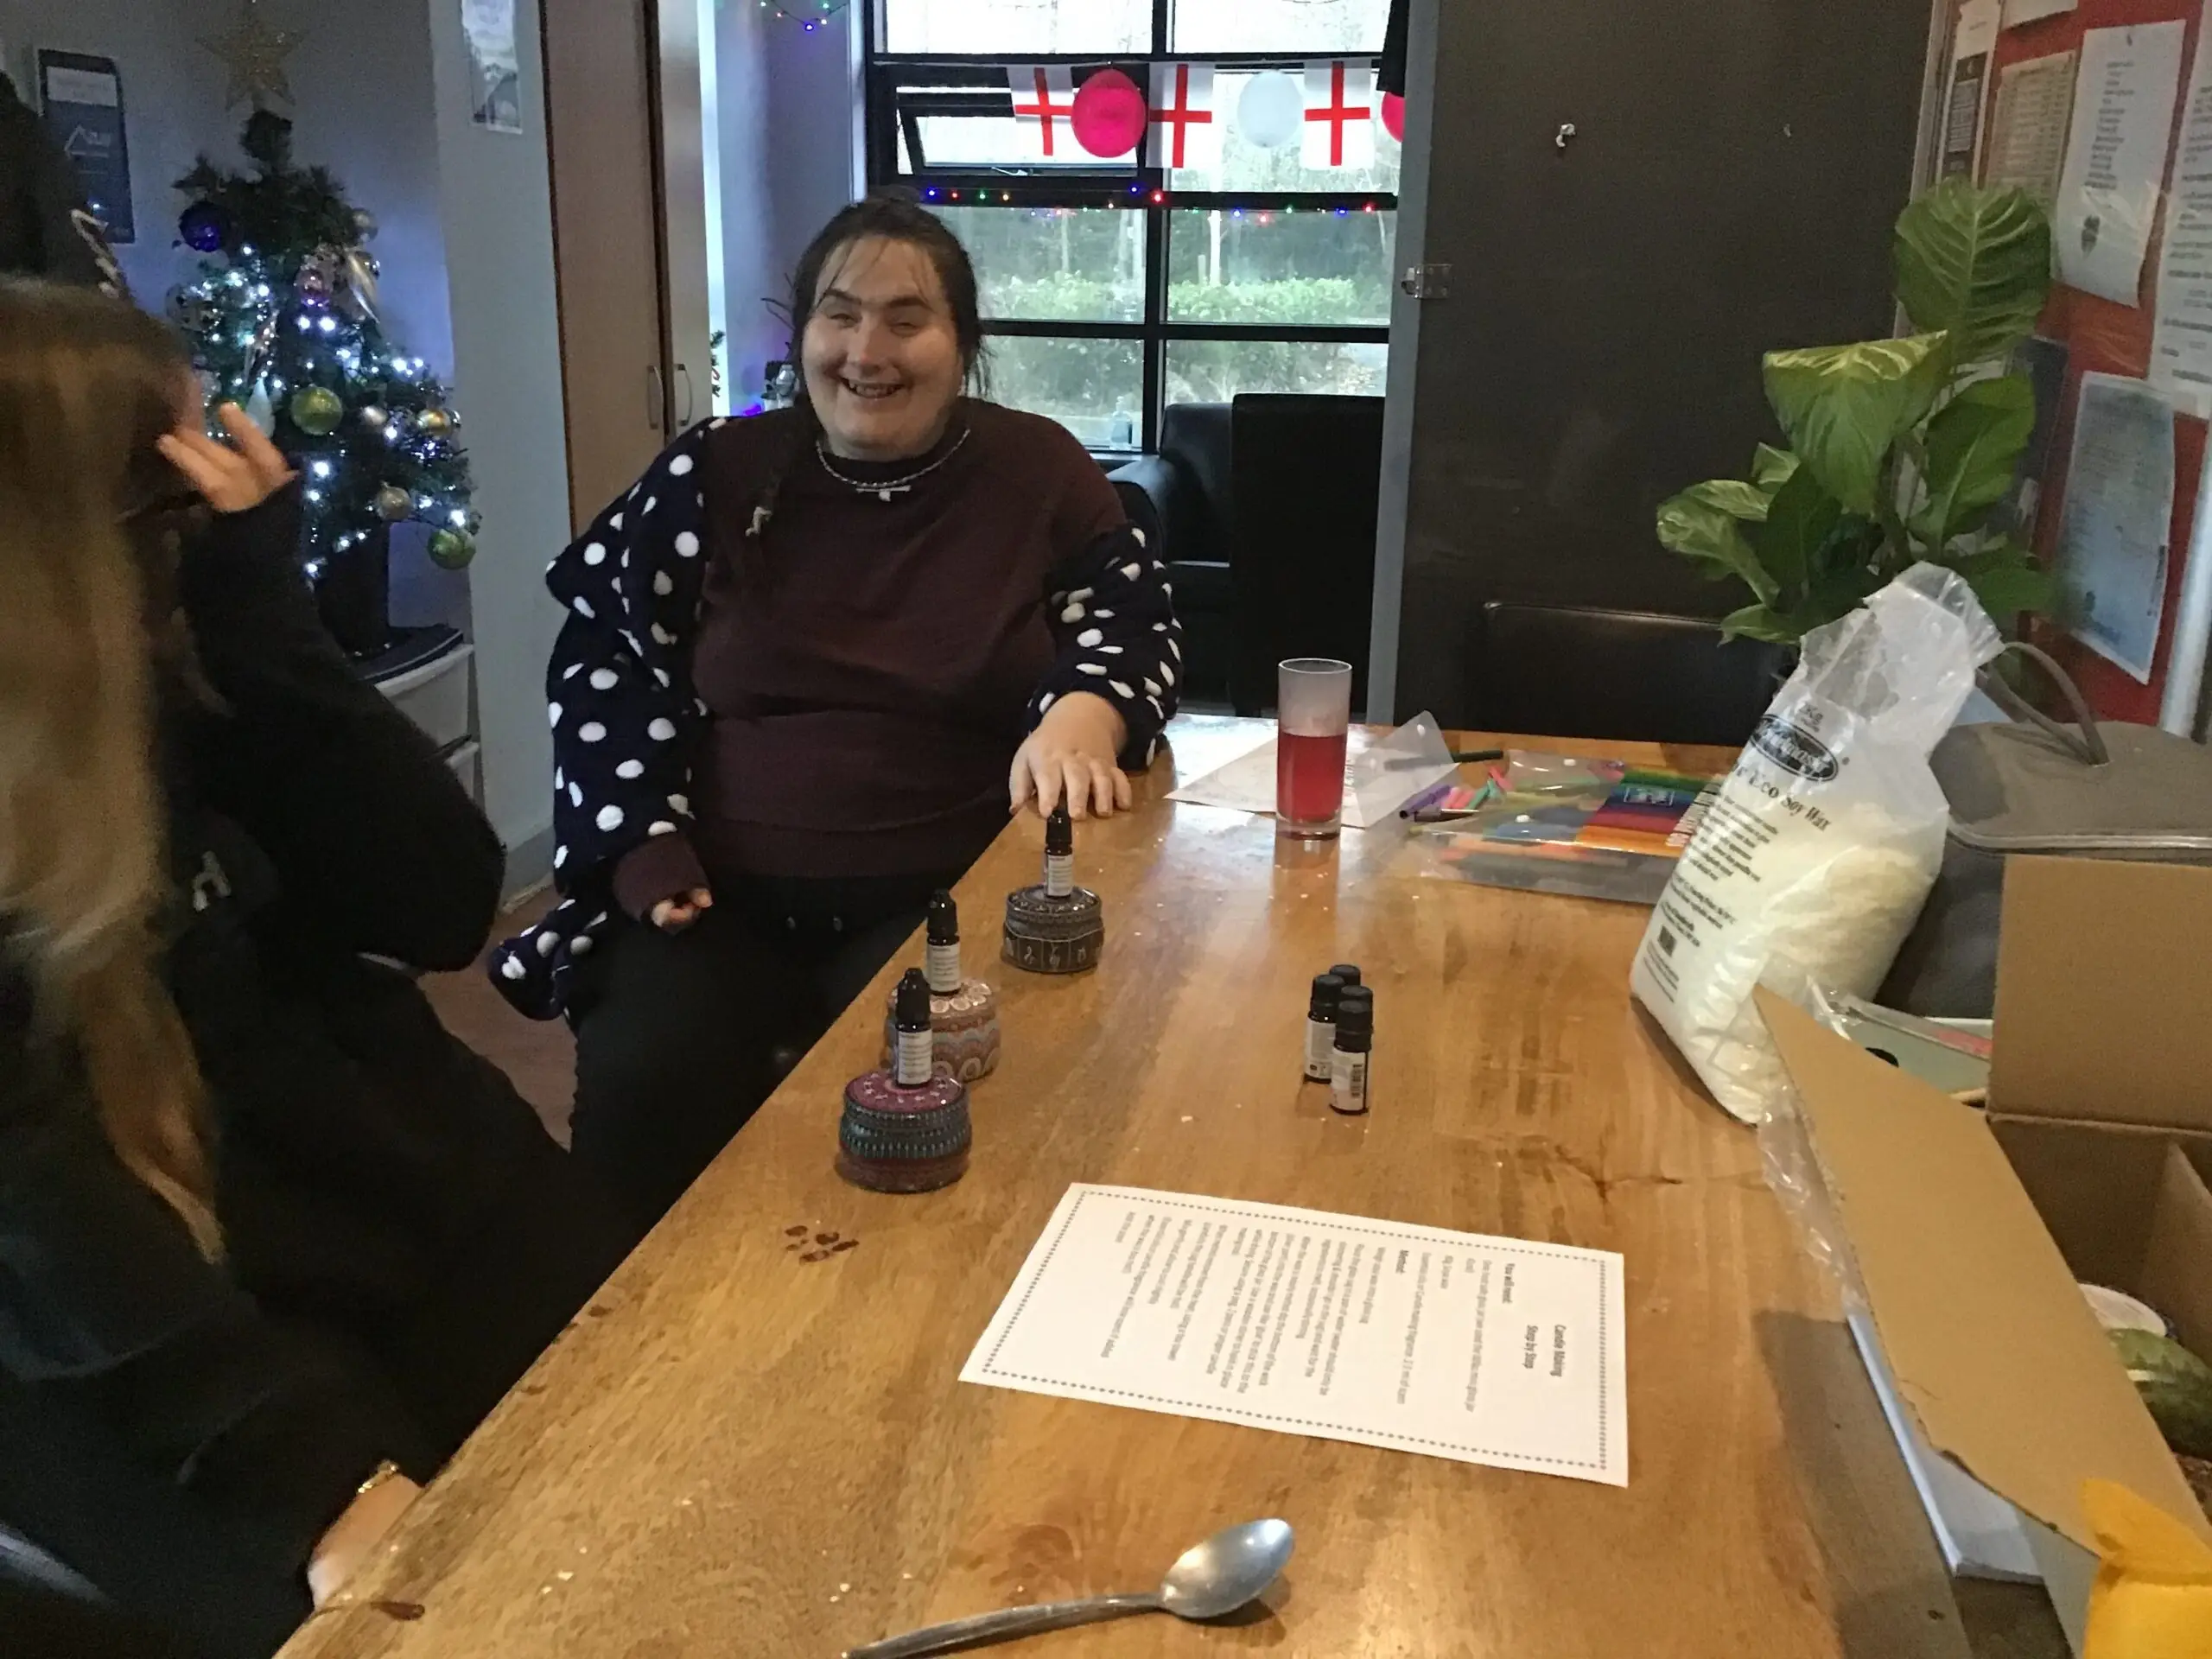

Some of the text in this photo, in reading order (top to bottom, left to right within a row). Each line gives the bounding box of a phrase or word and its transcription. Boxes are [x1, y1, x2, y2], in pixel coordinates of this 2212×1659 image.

[1780, 796, 1803, 817] Soy
[1804, 805, 1833, 832] Wax
[1522, 1325, 1538, 1369] Step by Step
[1554, 1325, 1567, 1349] Candle
